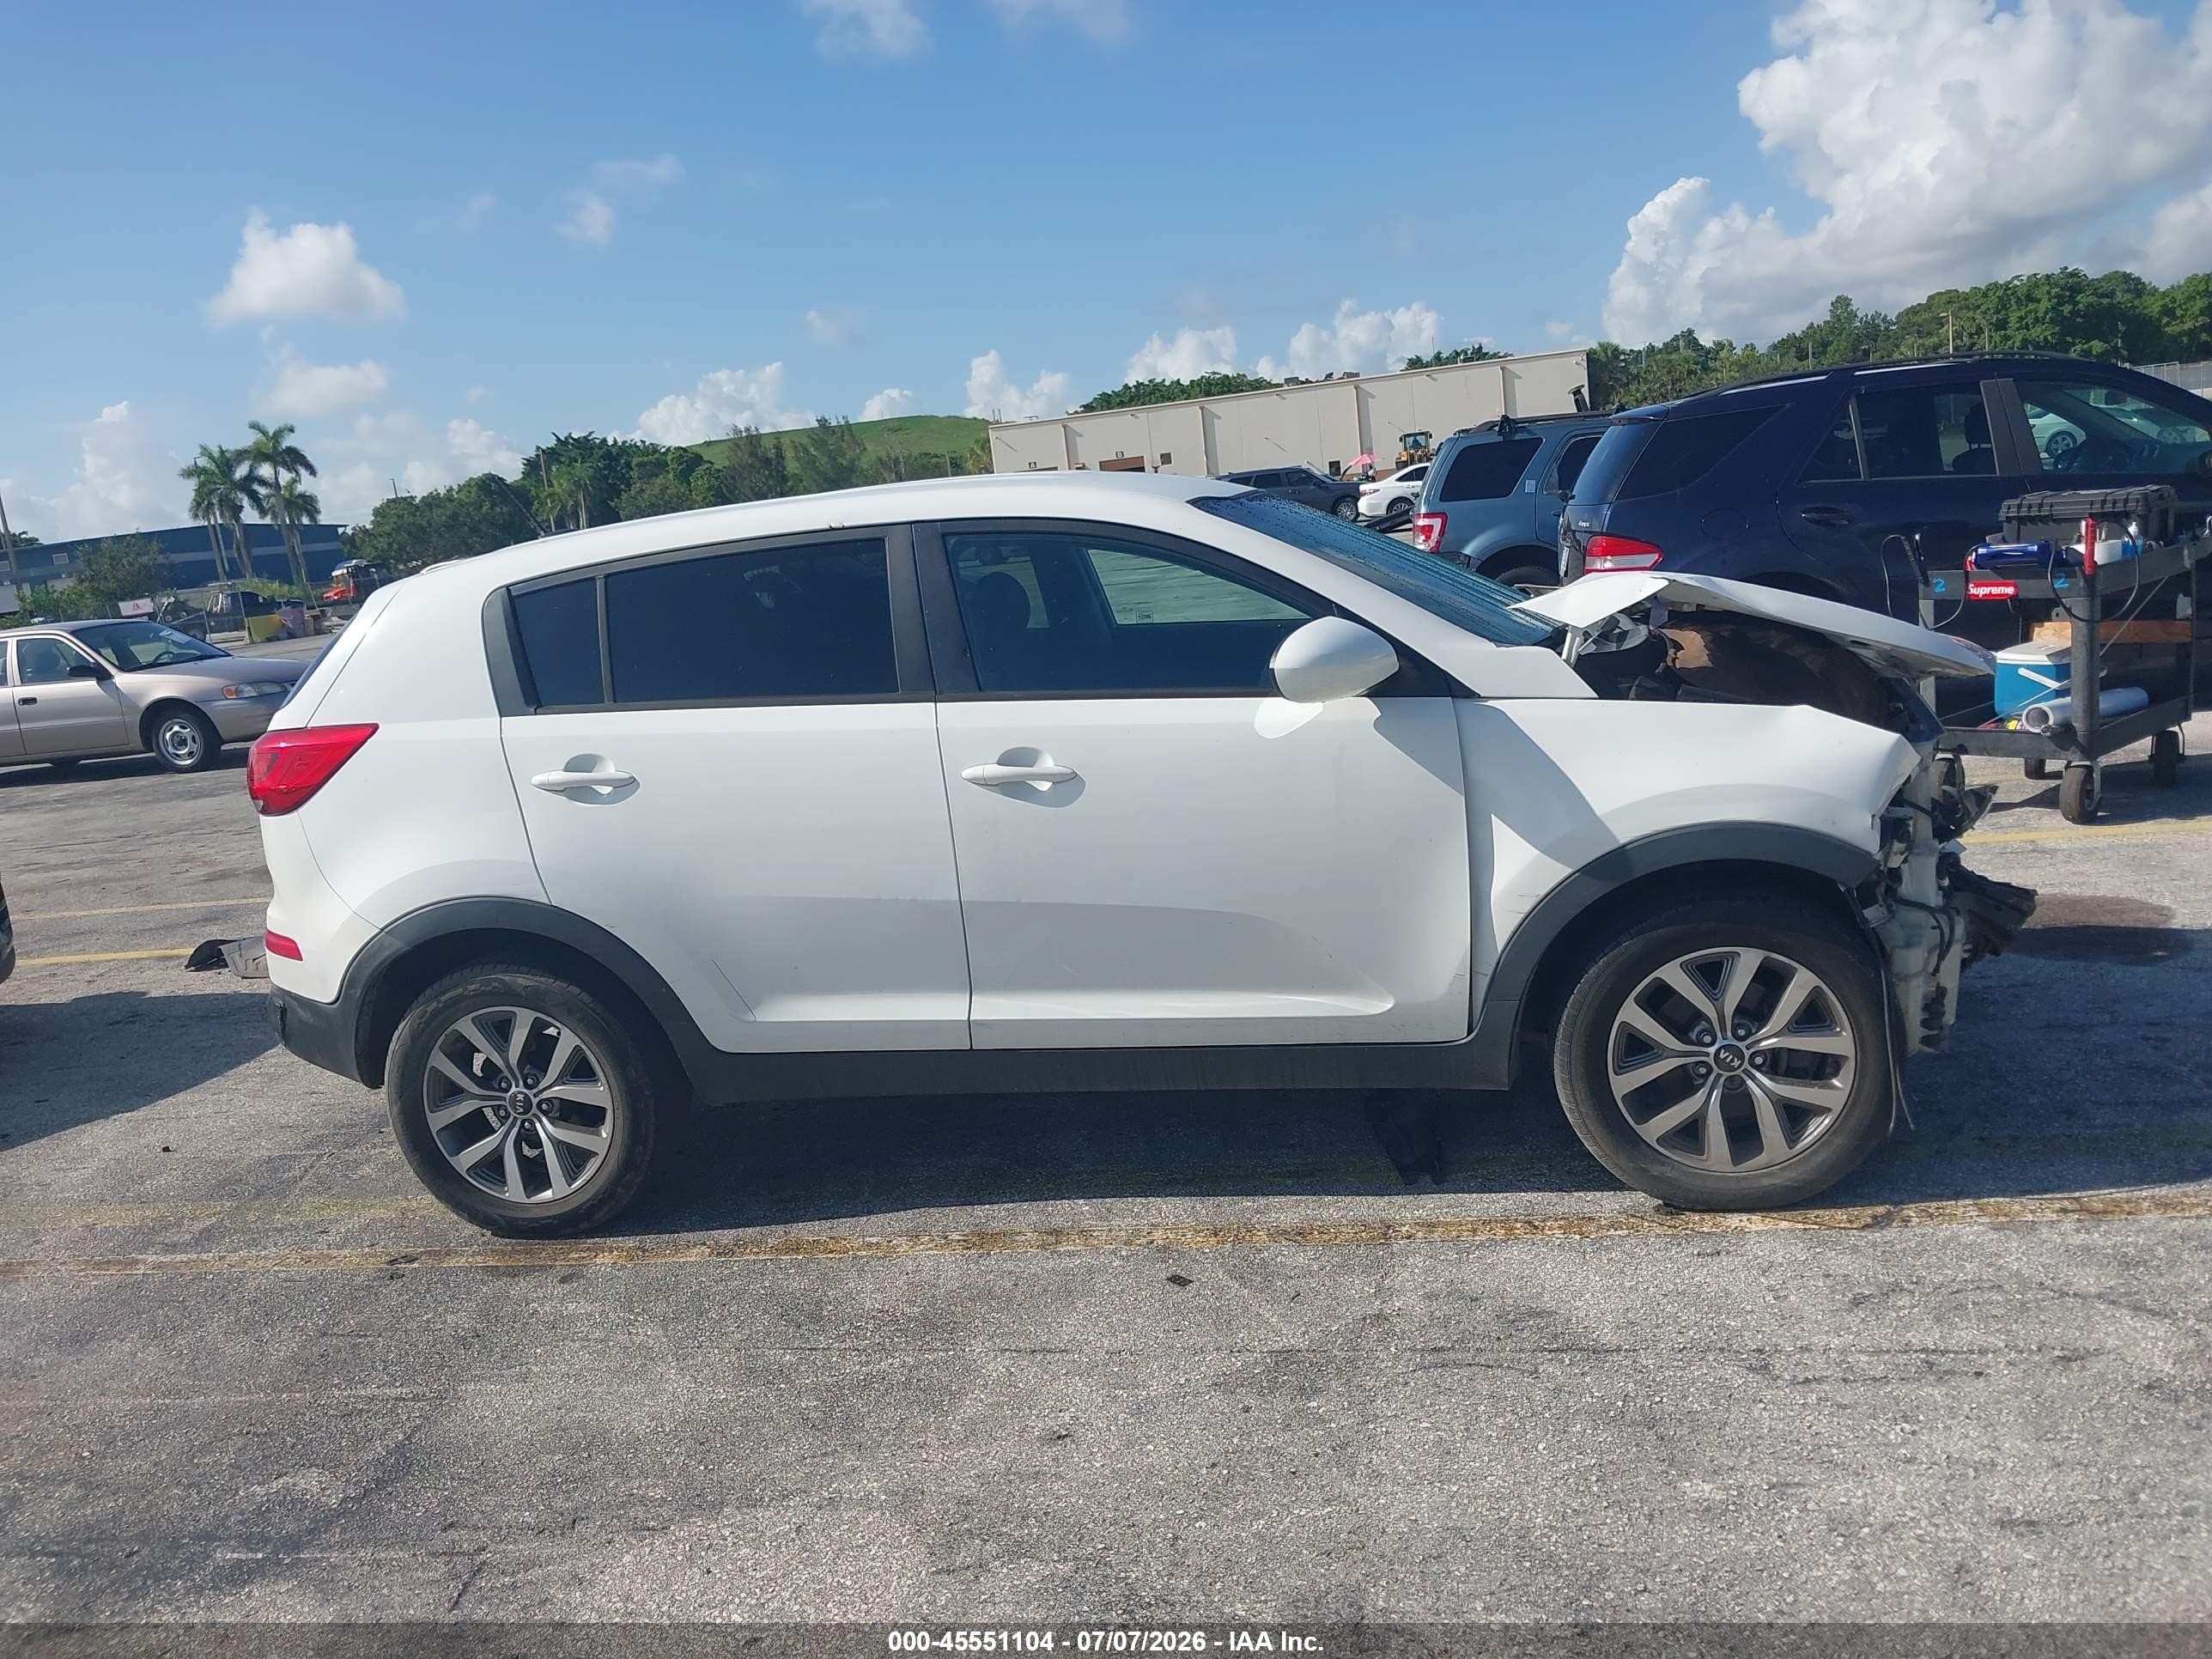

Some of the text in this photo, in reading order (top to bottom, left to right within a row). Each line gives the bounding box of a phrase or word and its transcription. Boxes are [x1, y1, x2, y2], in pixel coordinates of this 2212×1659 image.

[1933, 577, 1946, 592] 2
[2053, 573, 2069, 589] 2
[1967, 583, 2014, 598] Supreme
[1718, 1048, 1741, 1068] KIA
[515, 1093, 525, 1113] KIA
